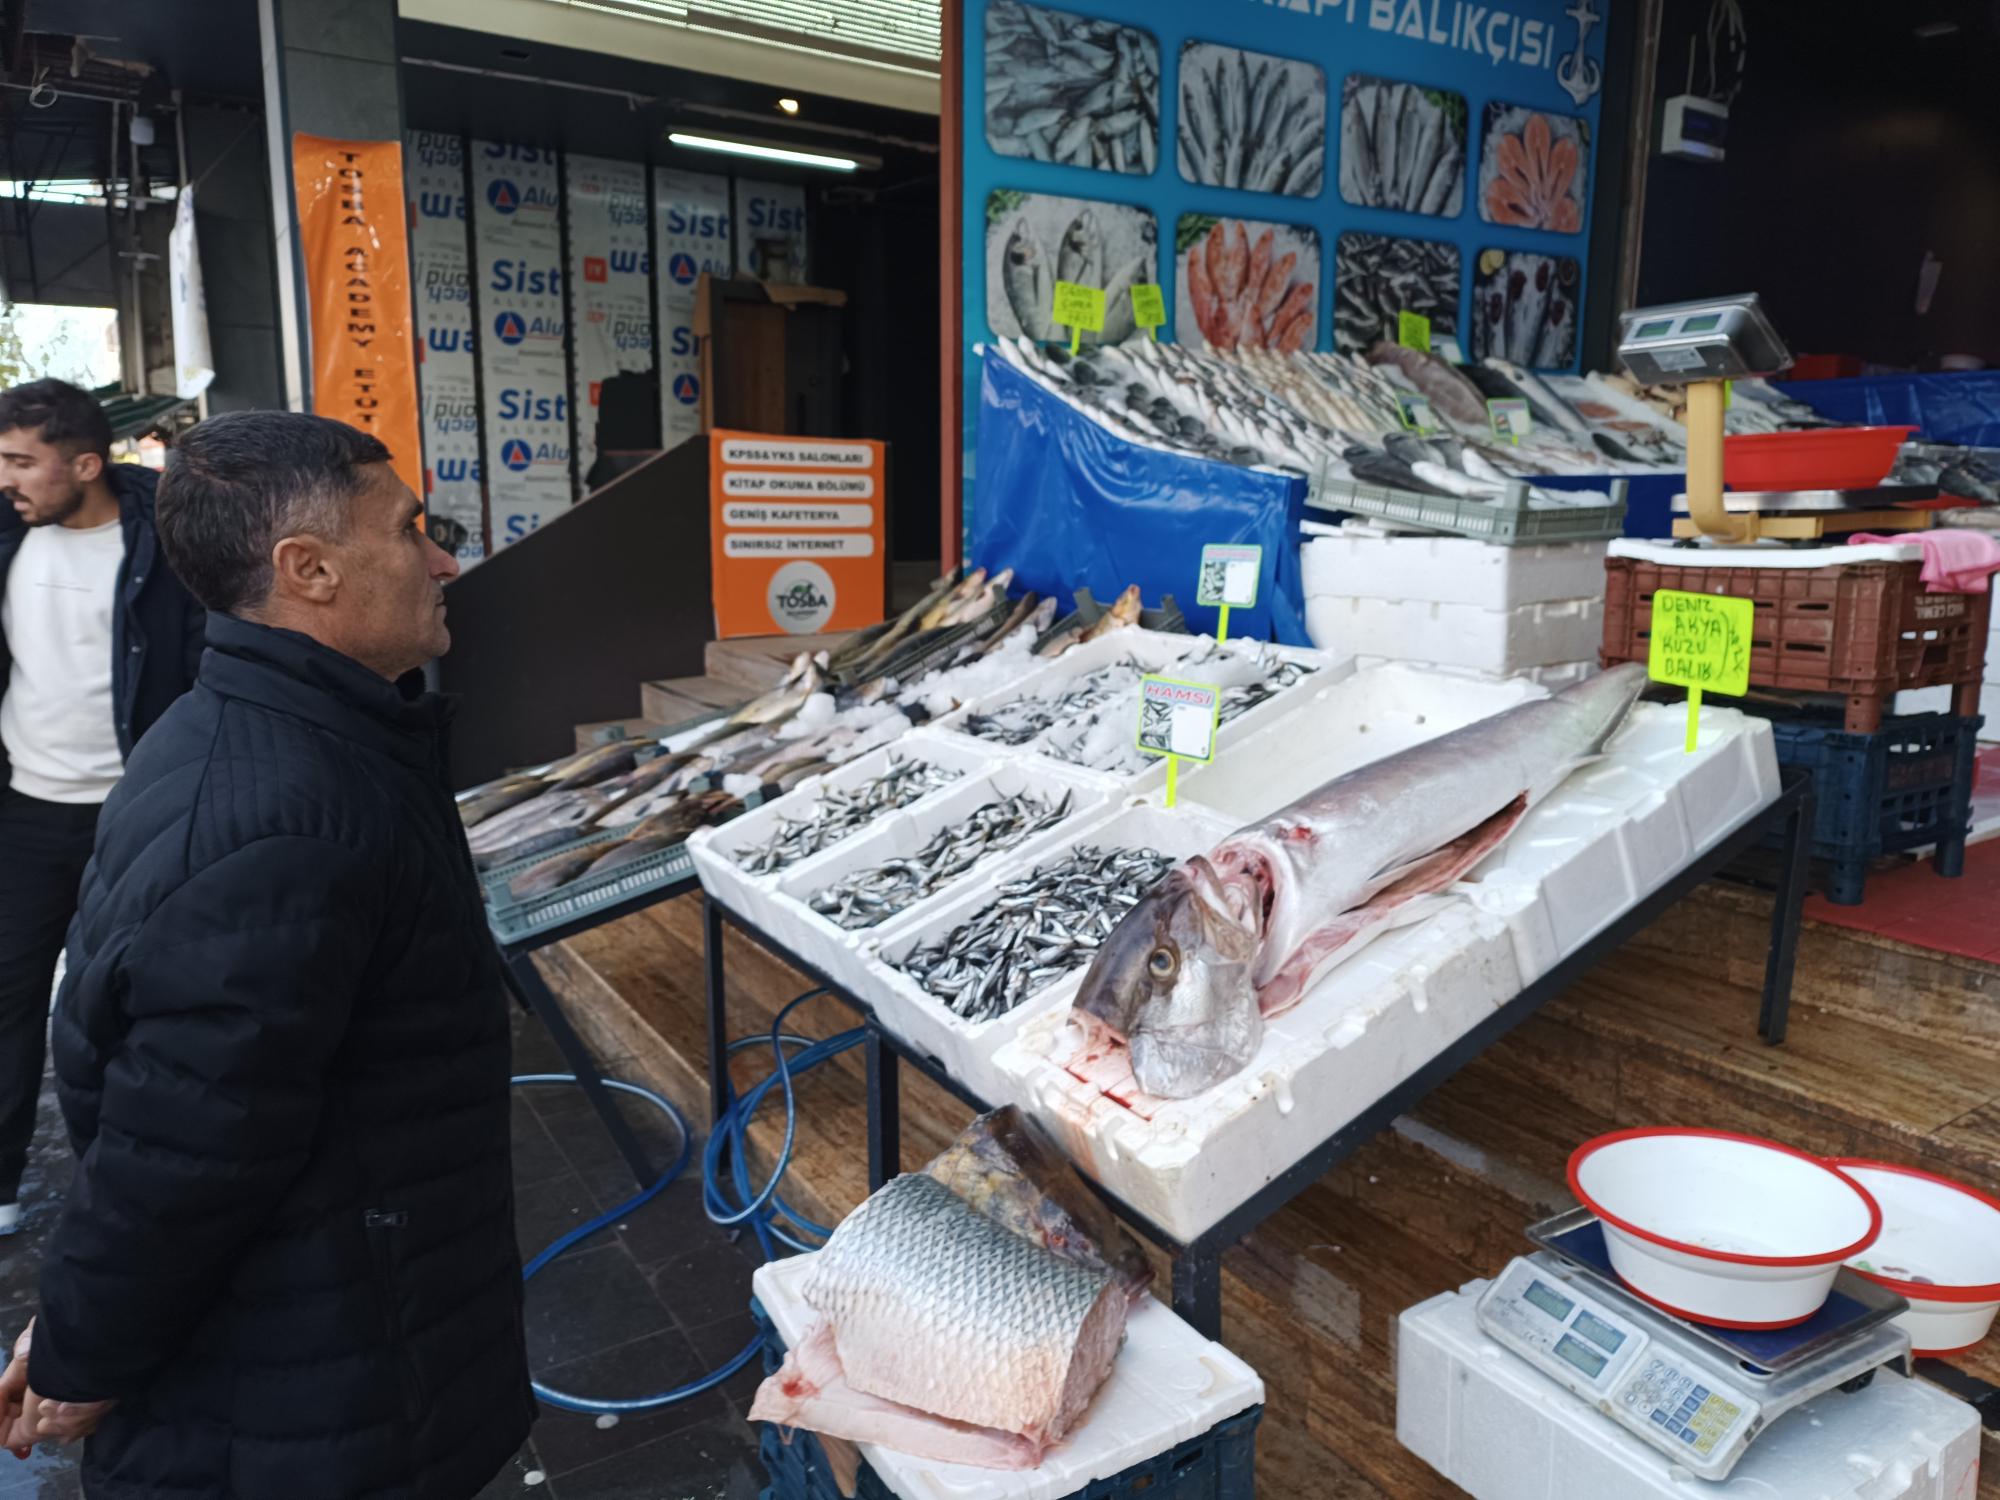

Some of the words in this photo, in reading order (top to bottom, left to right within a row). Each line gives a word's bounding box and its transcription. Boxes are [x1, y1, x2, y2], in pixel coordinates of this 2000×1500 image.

[1369, 0, 1555, 69] BALIKÇISI
[491, 258, 561, 297] Sist
[345, 247, 375, 348] ACADEMY
[498, 388, 567, 422] Sist
[799, 452, 863, 463] SALONLARI
[729, 478, 765, 489] KİTAP
[769, 480, 813, 491] OKUMA
[817, 479, 866, 492] BÖLÜMÜ
[730, 507, 767, 521] GENİŞ
[772, 510, 839, 520] KAFETERYA
[731, 540, 782, 550] SINIRSIZ
[776, 594, 829, 608] TOSBA
[1662, 635, 1707, 655] KUZU
